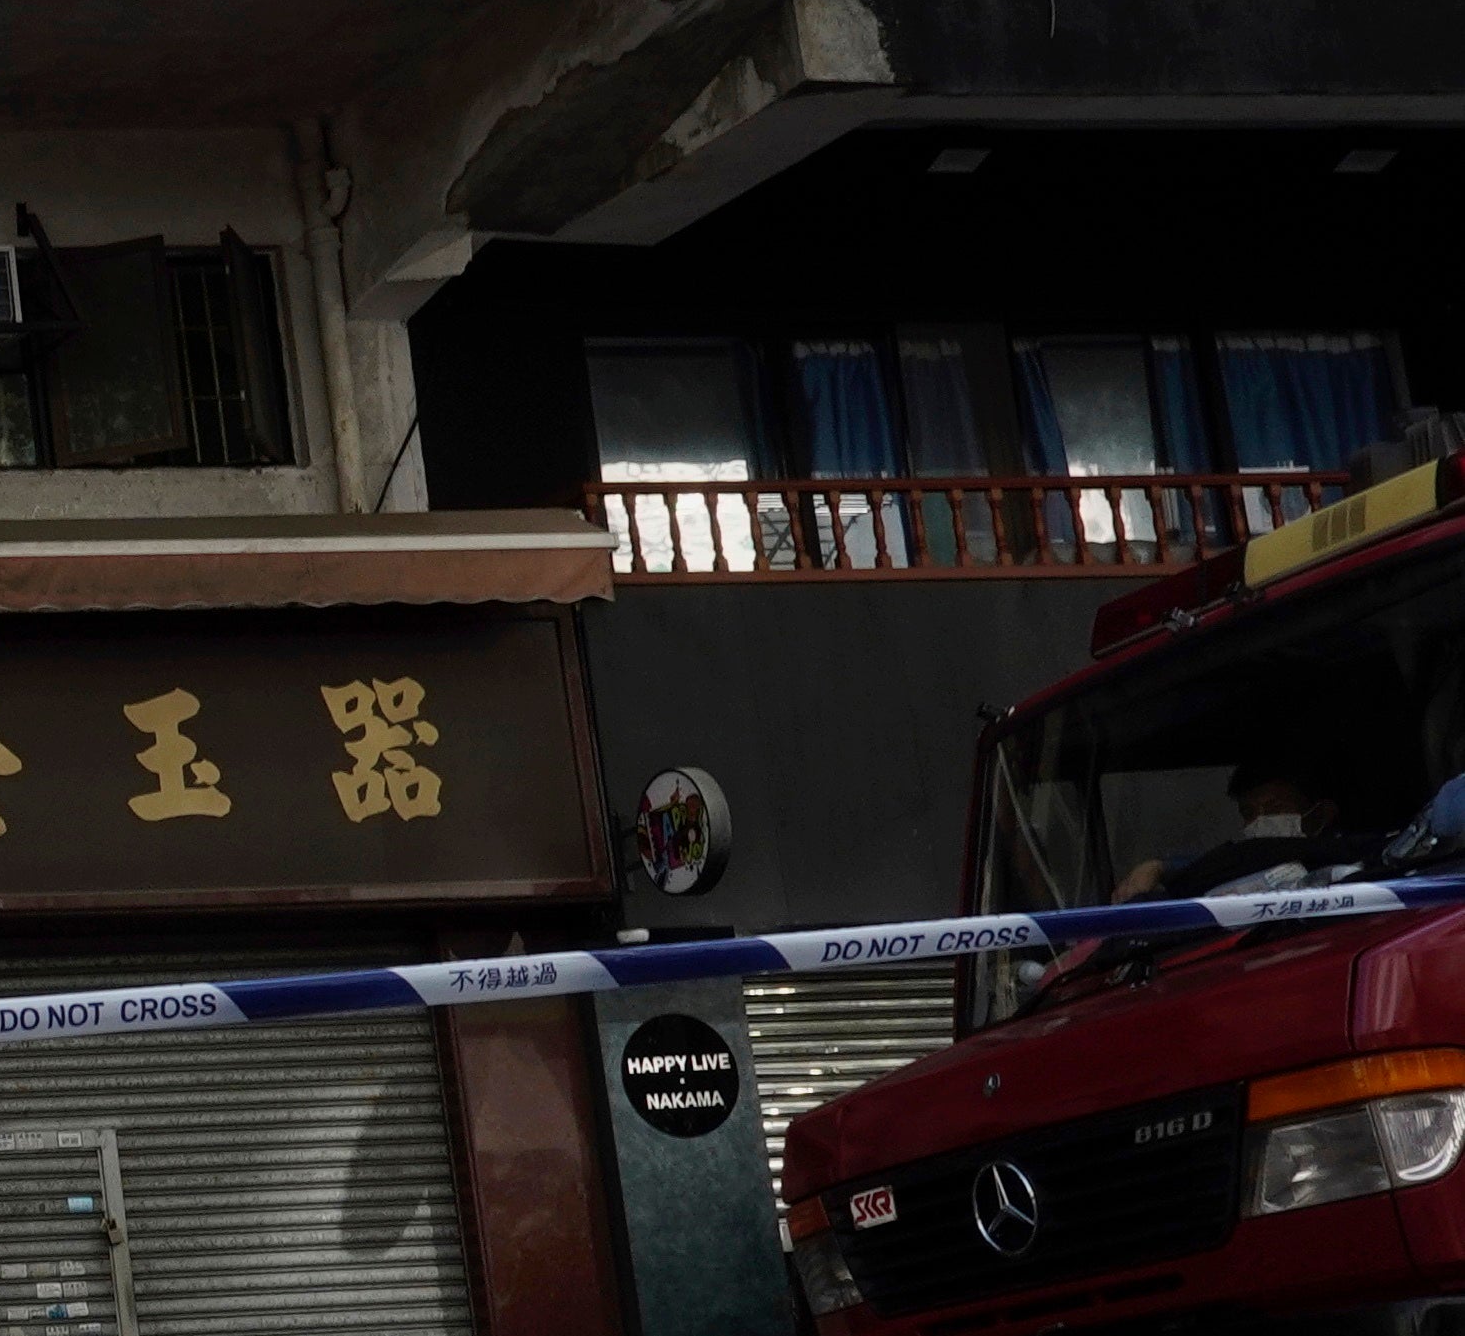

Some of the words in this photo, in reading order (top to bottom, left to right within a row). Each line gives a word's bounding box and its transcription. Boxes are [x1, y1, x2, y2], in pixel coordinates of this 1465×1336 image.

[820, 940, 863, 963] DO
[868, 934, 926, 960] NOT
[936, 926, 1031, 953] CROSS
[448, 962, 559, 992] 不得越過
[0, 1008, 41, 1032] DO
[47, 1002, 105, 1031] NOT
[120, 993, 217, 1025] CROSS
[627, 1054, 687, 1075] HAPPY
[691, 1052, 732, 1072] LIVE
[645, 1090, 725, 1111] NAKAMA
[1192, 1111, 1213, 1131] D
